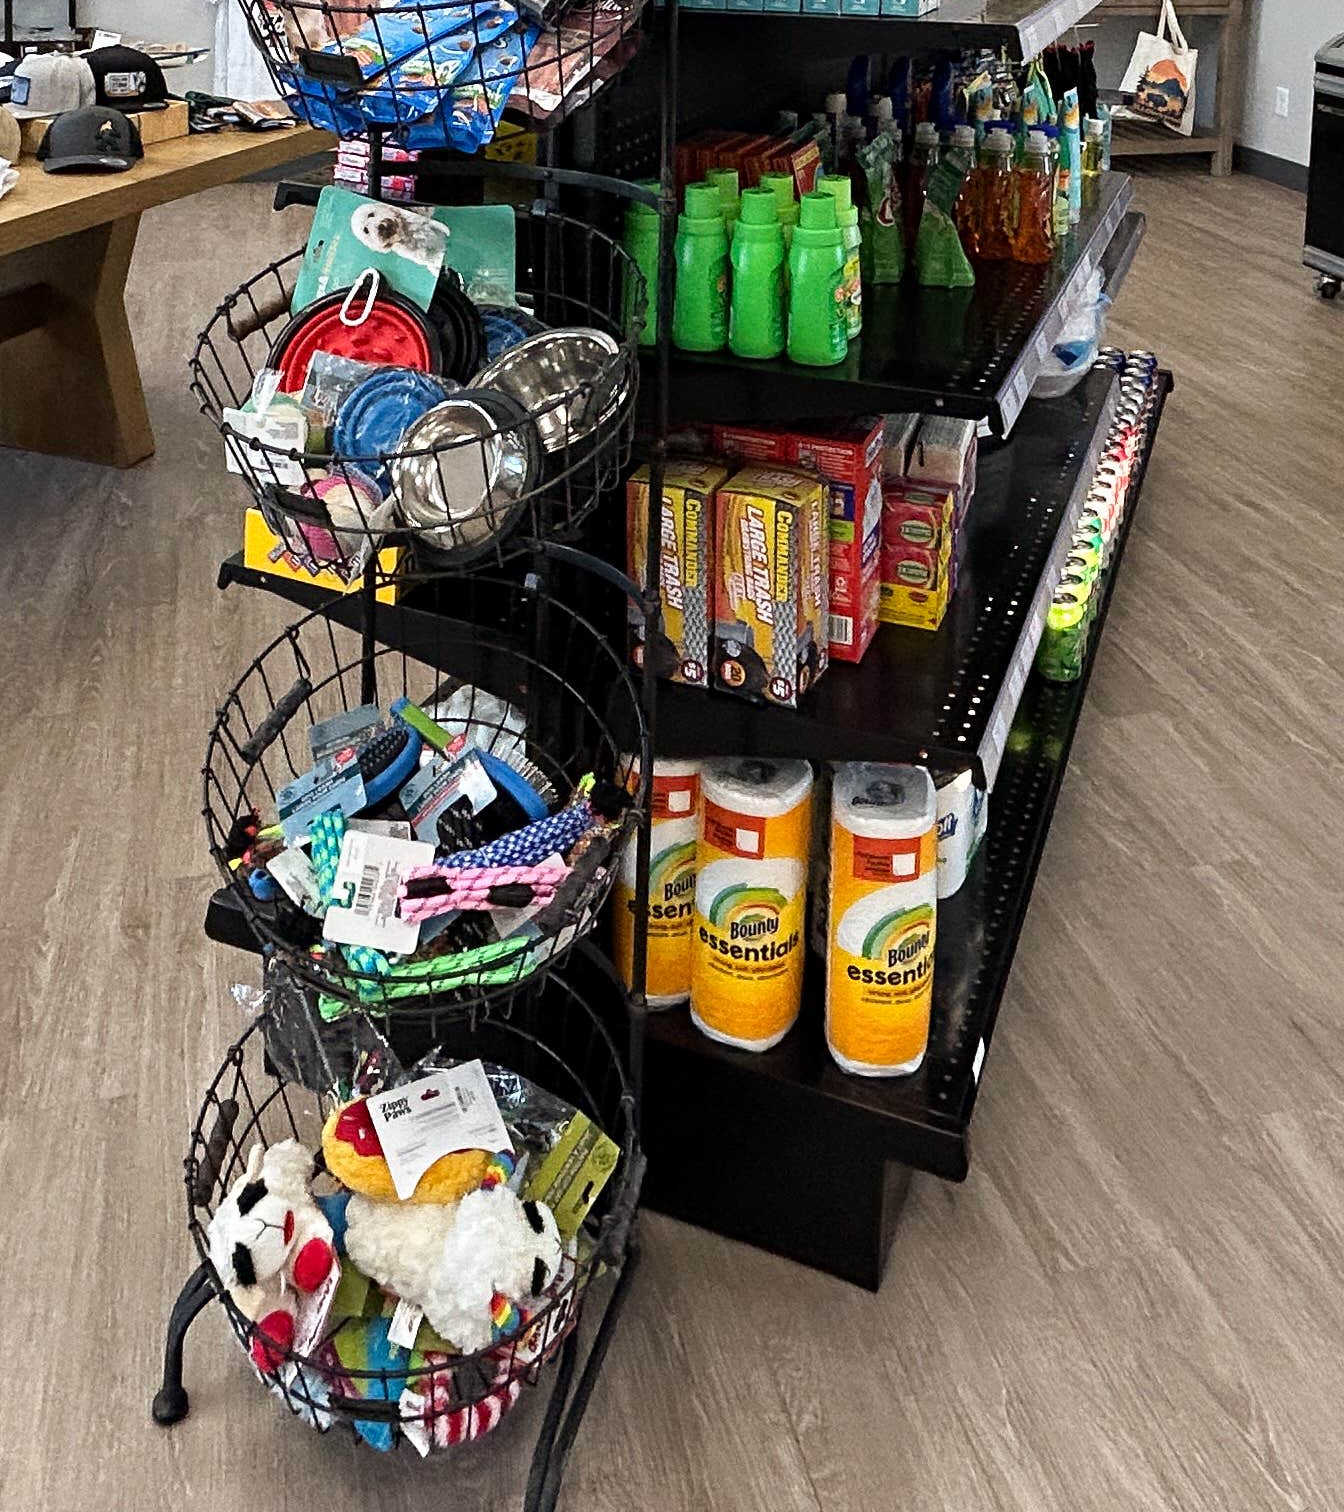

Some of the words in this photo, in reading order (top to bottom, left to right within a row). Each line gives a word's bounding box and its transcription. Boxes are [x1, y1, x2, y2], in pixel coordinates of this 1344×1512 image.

[661, 495, 678, 550] LARGE
[746, 504, 769, 563] LARGE
[685, 497, 702, 588] COMMANDER
[775, 509, 793, 603] COMMANDER
[662, 553, 684, 610] TRASH
[751, 566, 774, 626] TRASH
[684, 661, 698, 679] $5
[730, 665, 742, 682] 20
[774, 678, 789, 698] $5
[665, 873, 696, 902] Boun
[699, 924, 800, 962] essentials
[730, 916, 779, 940] Bounty
[847, 952, 934, 986] essenti
[380, 1096, 410, 1114] Zippy
[383, 1107, 412, 1123] Paws
